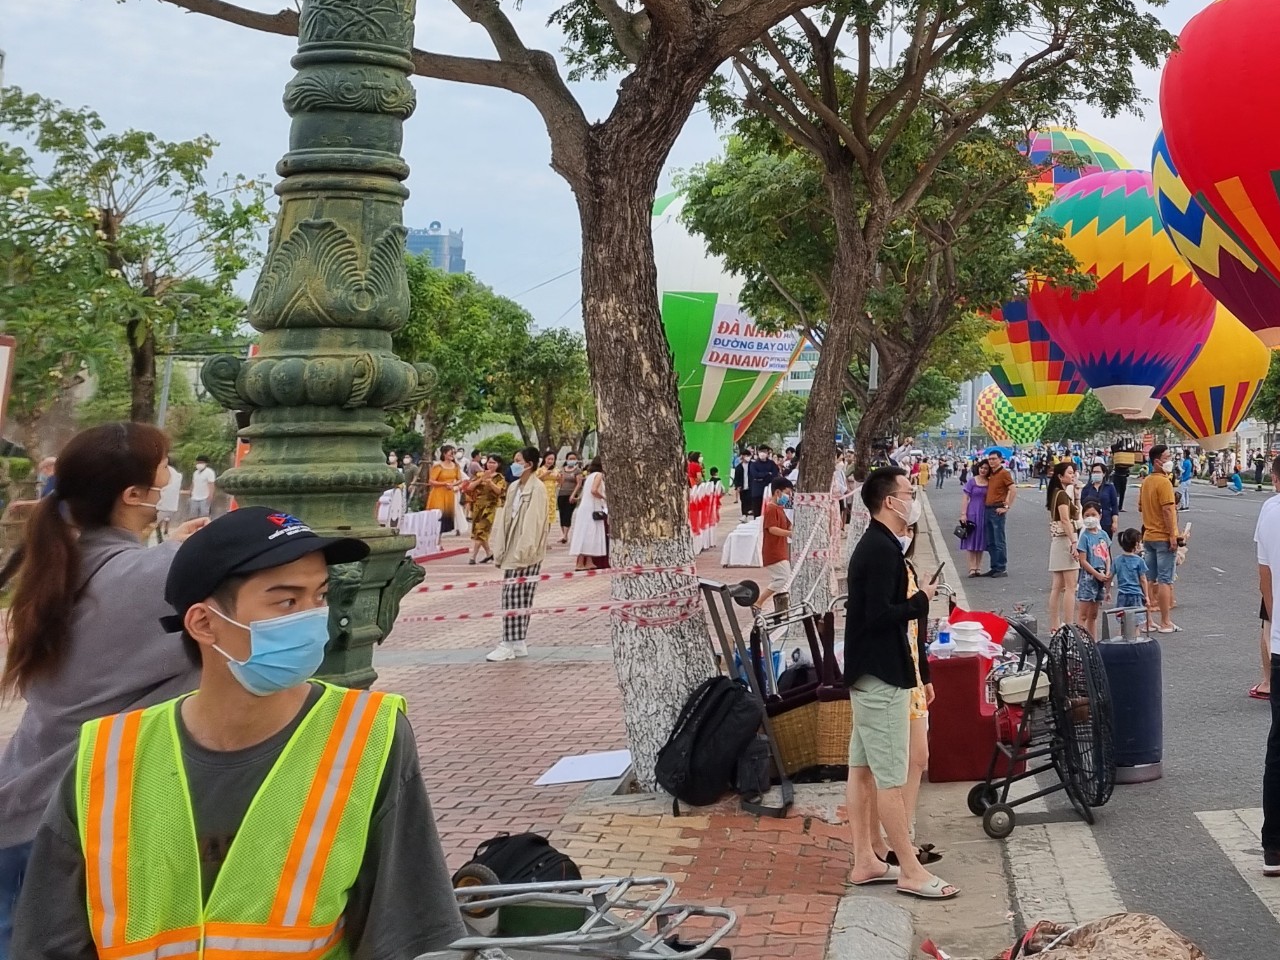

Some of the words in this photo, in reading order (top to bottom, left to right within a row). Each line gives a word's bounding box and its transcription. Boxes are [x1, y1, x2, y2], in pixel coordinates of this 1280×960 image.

[717, 319, 740, 336] ĐÀ
[713, 337, 755, 350] ĐƯỜNG
[756, 341, 776, 351] BAY
[708, 350, 769, 368] DANANG
